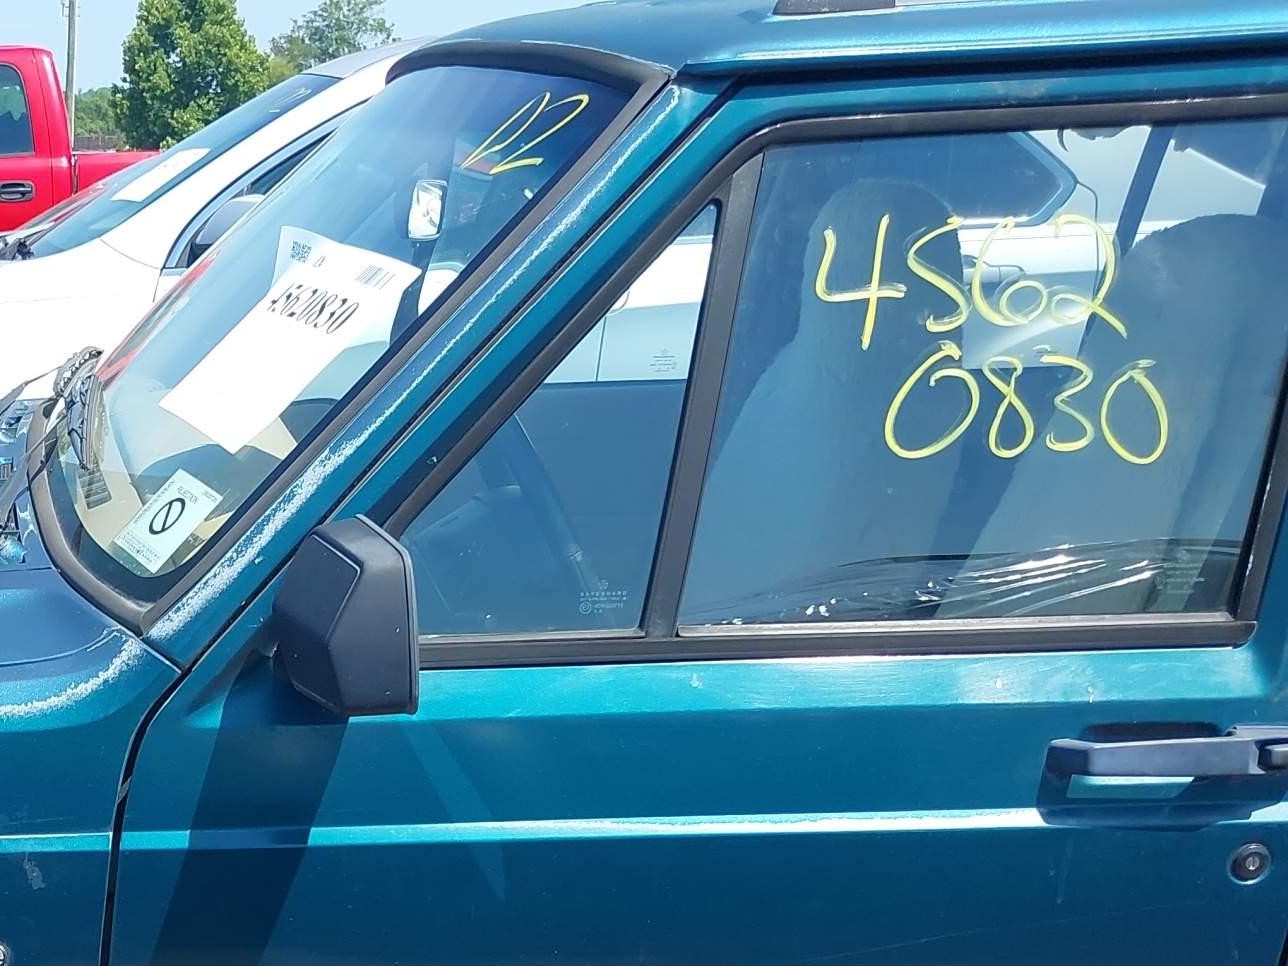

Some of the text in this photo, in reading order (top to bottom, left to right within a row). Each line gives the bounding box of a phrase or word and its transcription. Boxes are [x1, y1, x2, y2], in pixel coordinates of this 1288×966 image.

[266, 282, 360, 335] 45620830
[815, 212, 1128, 351] 4562
[884, 340, 1168, 464] 0830
